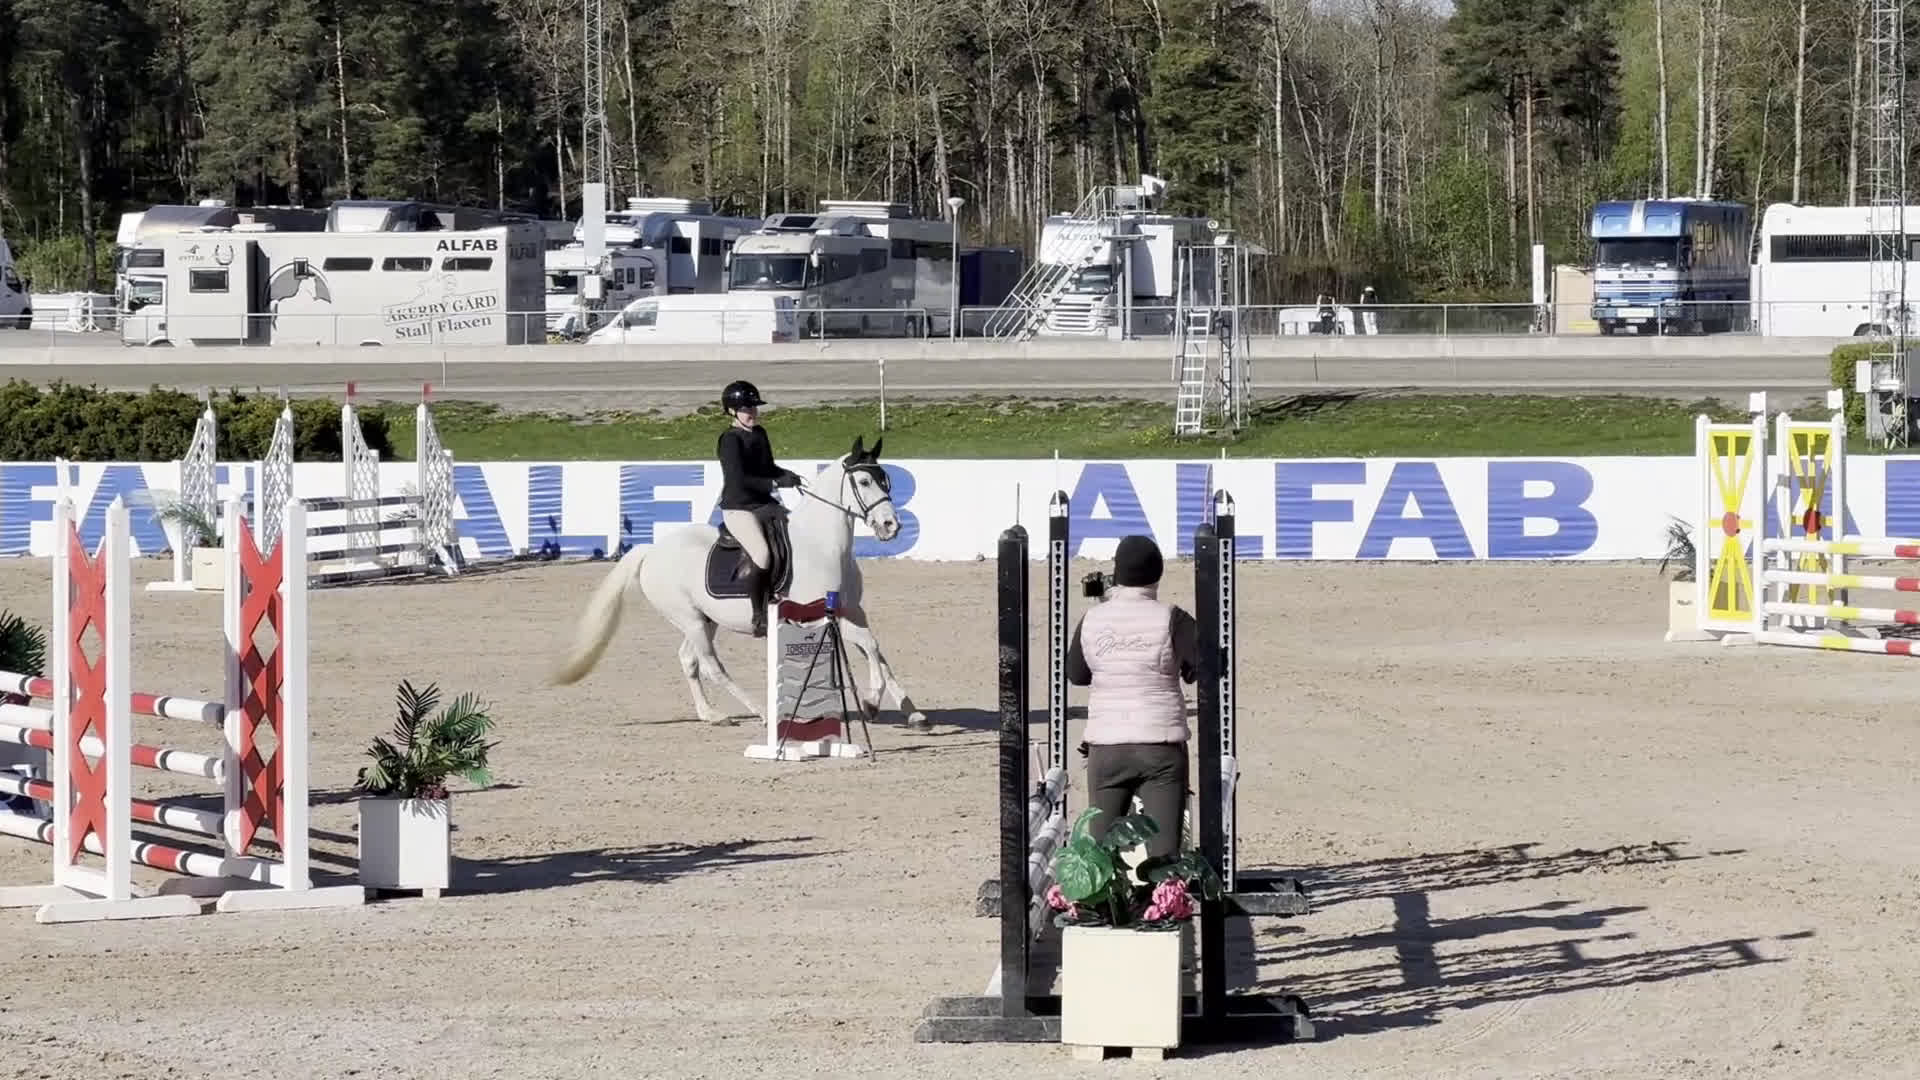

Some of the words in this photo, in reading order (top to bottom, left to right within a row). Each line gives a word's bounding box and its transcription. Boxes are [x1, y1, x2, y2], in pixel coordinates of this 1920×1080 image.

[436, 239, 498, 251] ALFAB
[437, 316, 492, 333] Flaxen
[452, 465, 920, 558] ALFB
[1068, 462, 1599, 559] ALFAB
